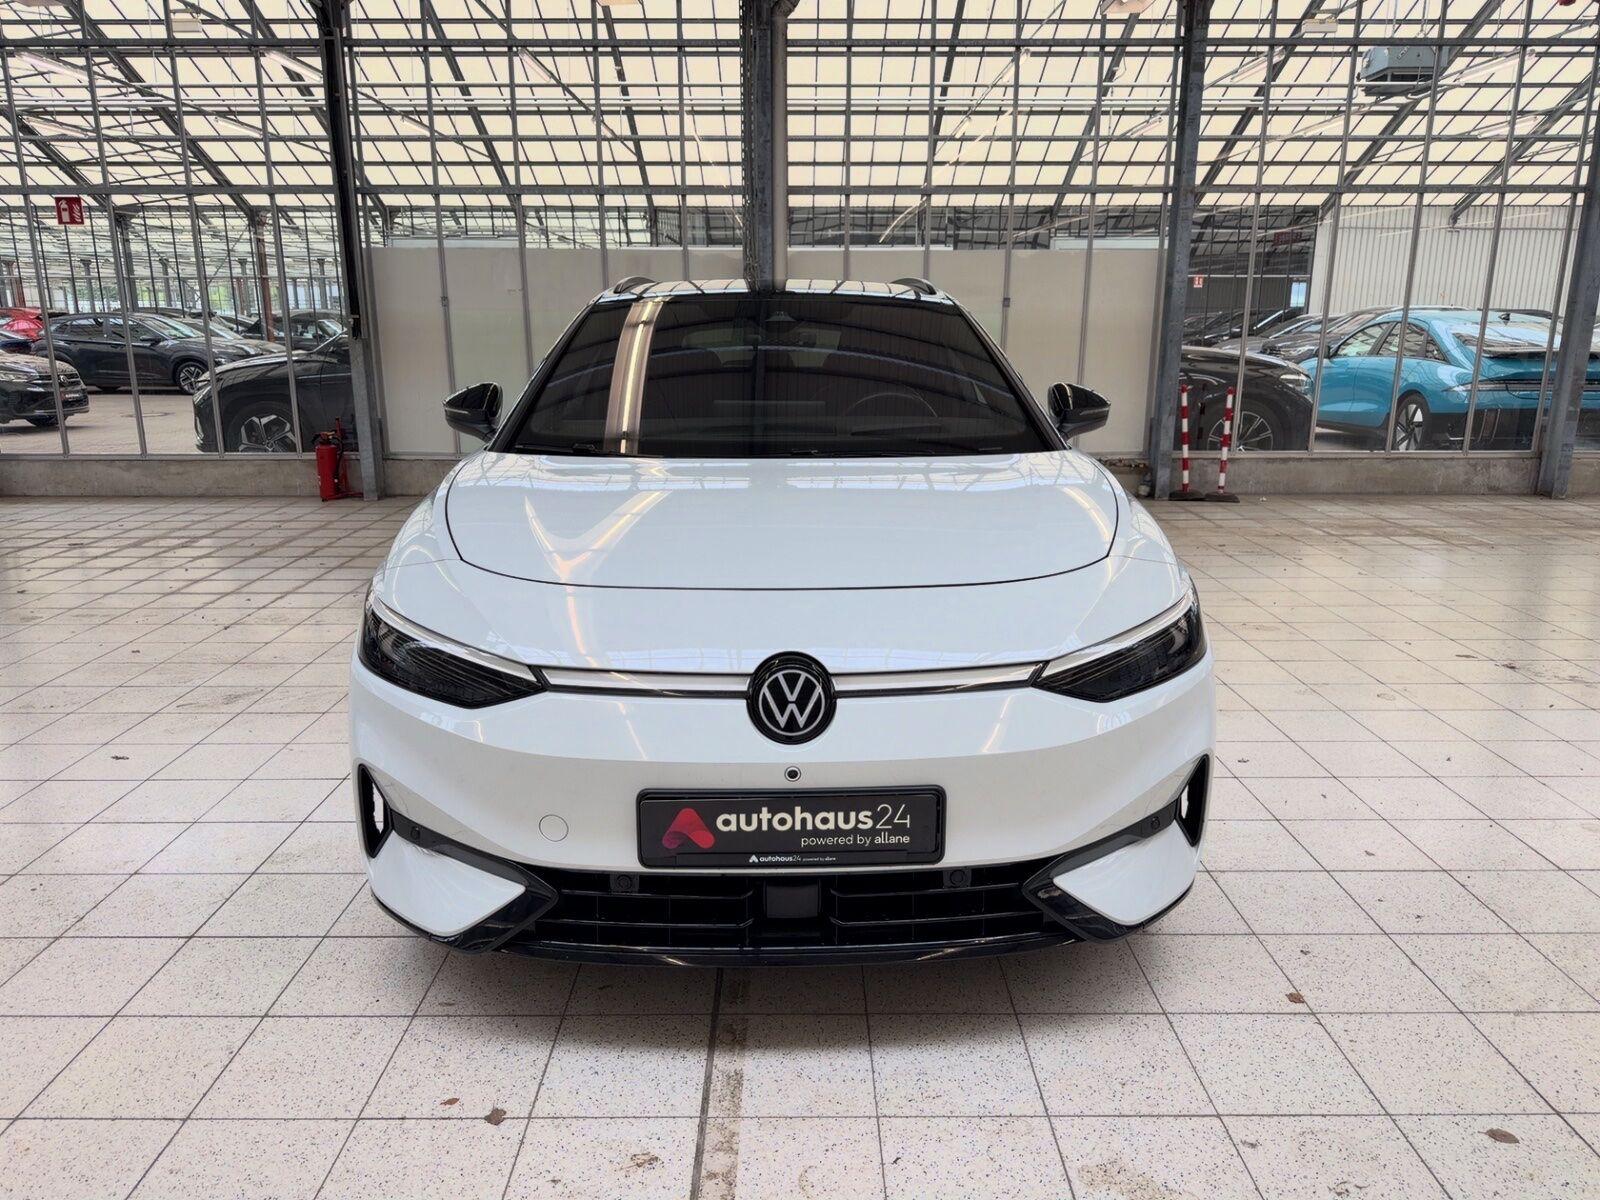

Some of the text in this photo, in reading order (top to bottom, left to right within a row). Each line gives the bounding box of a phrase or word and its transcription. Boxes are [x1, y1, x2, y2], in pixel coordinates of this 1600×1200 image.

[716, 804, 910, 832] autohaus24
[801, 831, 910, 847] powered by allane
